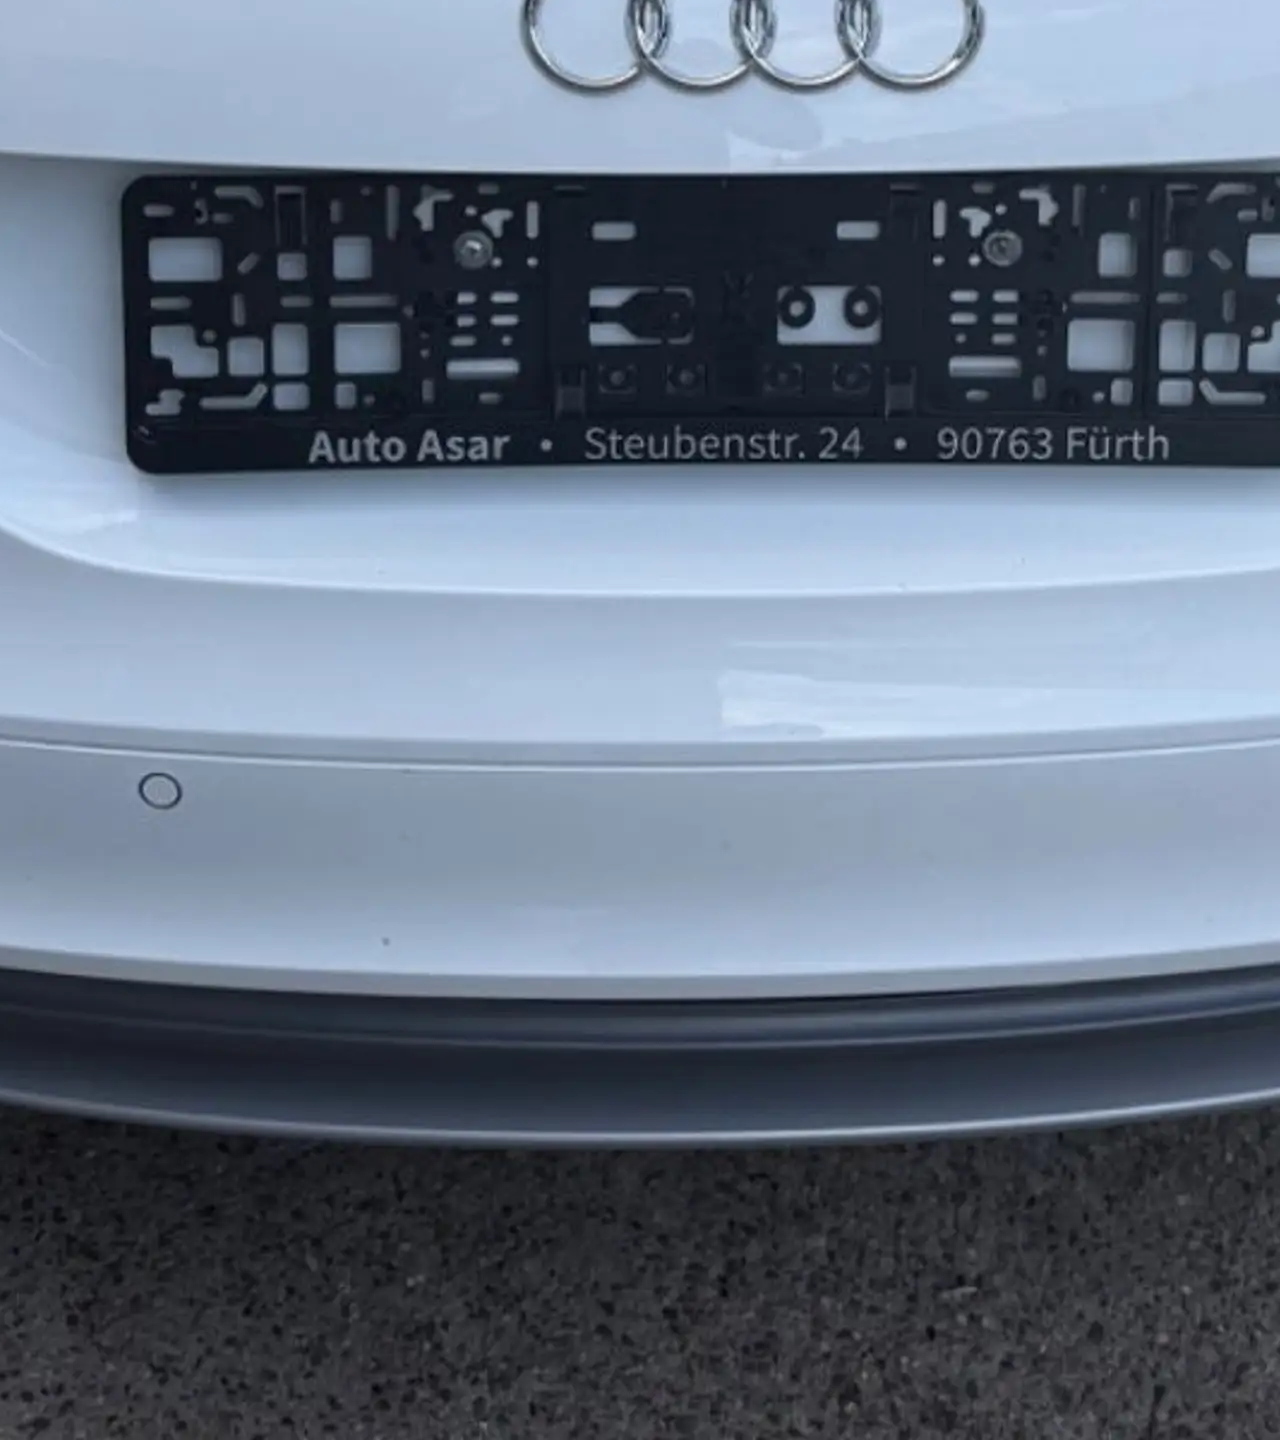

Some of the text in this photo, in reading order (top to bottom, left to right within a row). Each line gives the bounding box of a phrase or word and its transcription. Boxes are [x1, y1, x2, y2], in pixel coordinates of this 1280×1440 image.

[308, 424, 1170, 463] Auto Asar Steubenstr. 24 90763 Fürth
